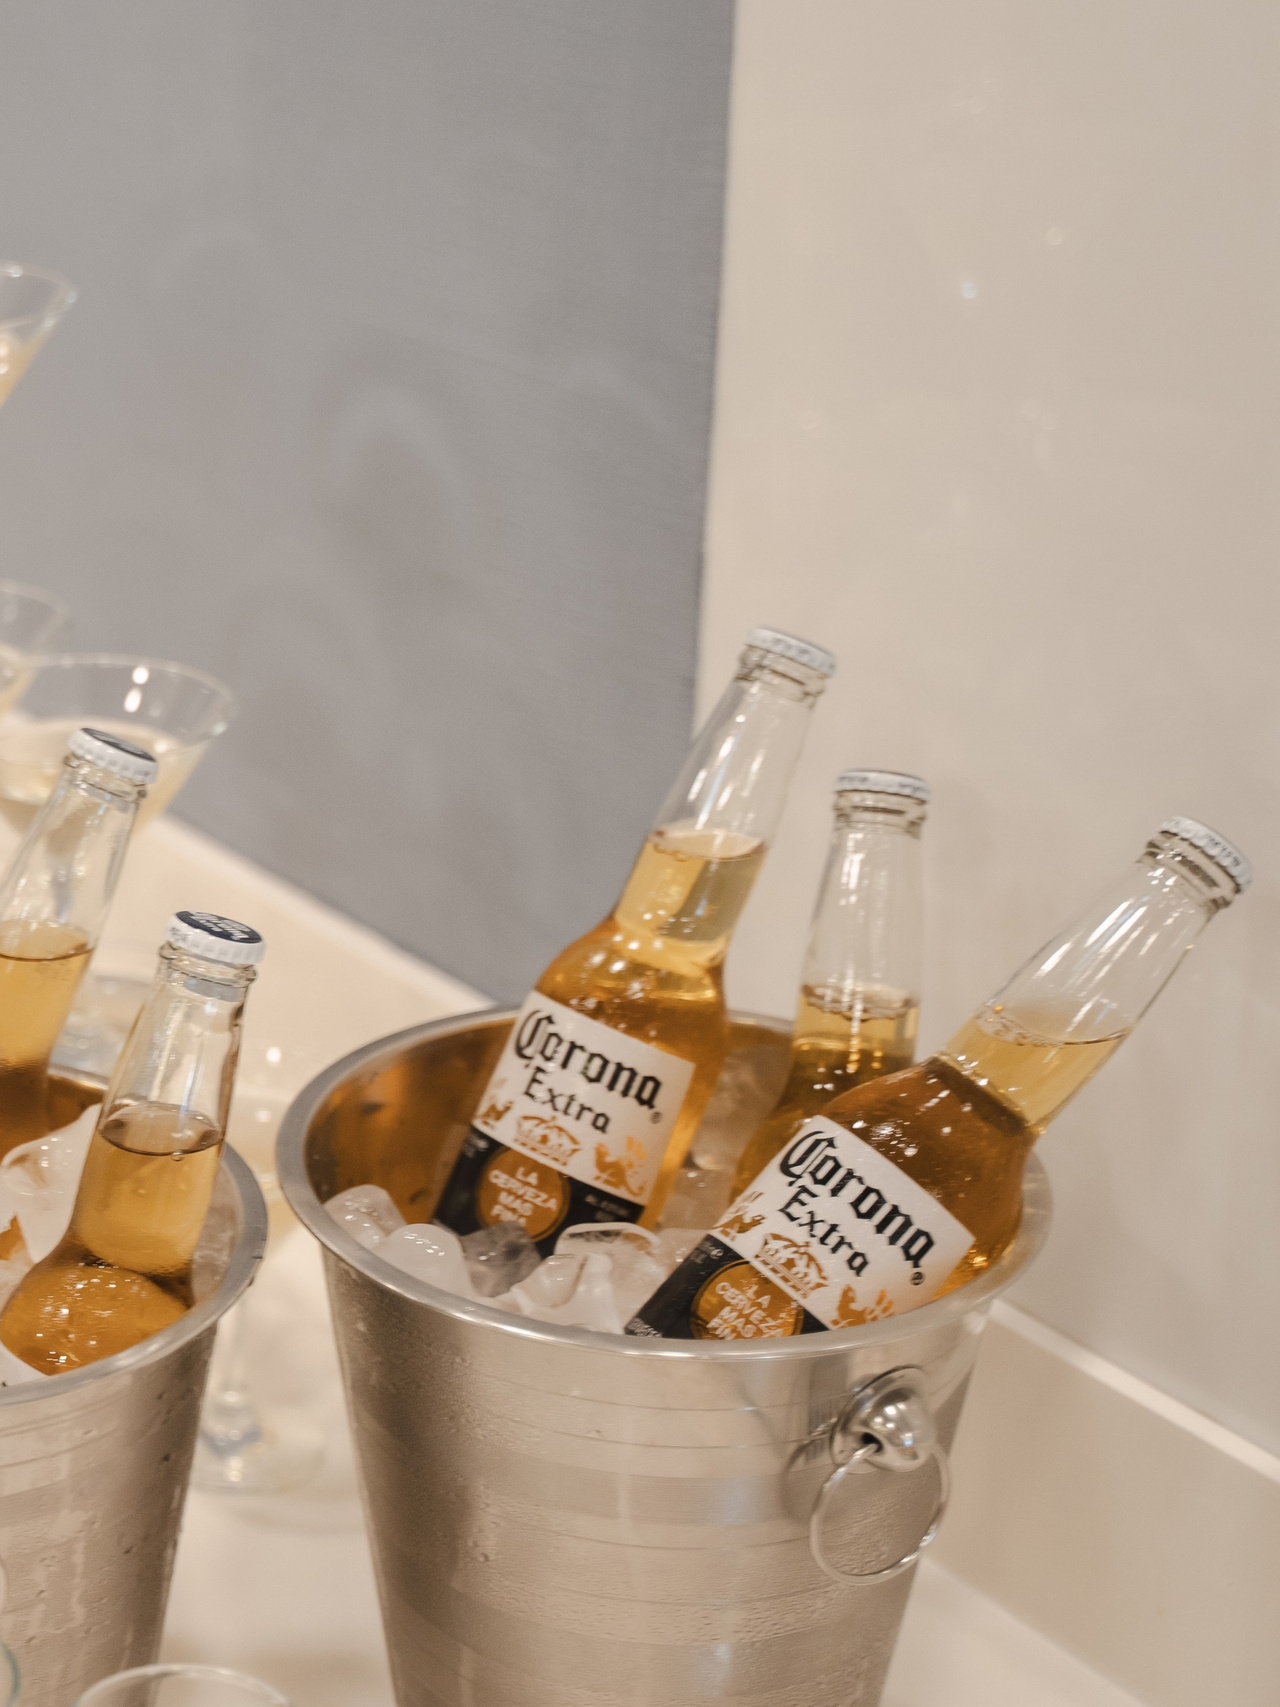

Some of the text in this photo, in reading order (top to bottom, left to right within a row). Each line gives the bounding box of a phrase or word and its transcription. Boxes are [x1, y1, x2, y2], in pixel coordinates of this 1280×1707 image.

[515, 1010, 662, 1109] Corona
[524, 1065, 611, 1134] Extra
[516, 1167, 538, 1186] LA
[780, 1130, 935, 1269] Corona
[779, 1186, 869, 1277] Extra
